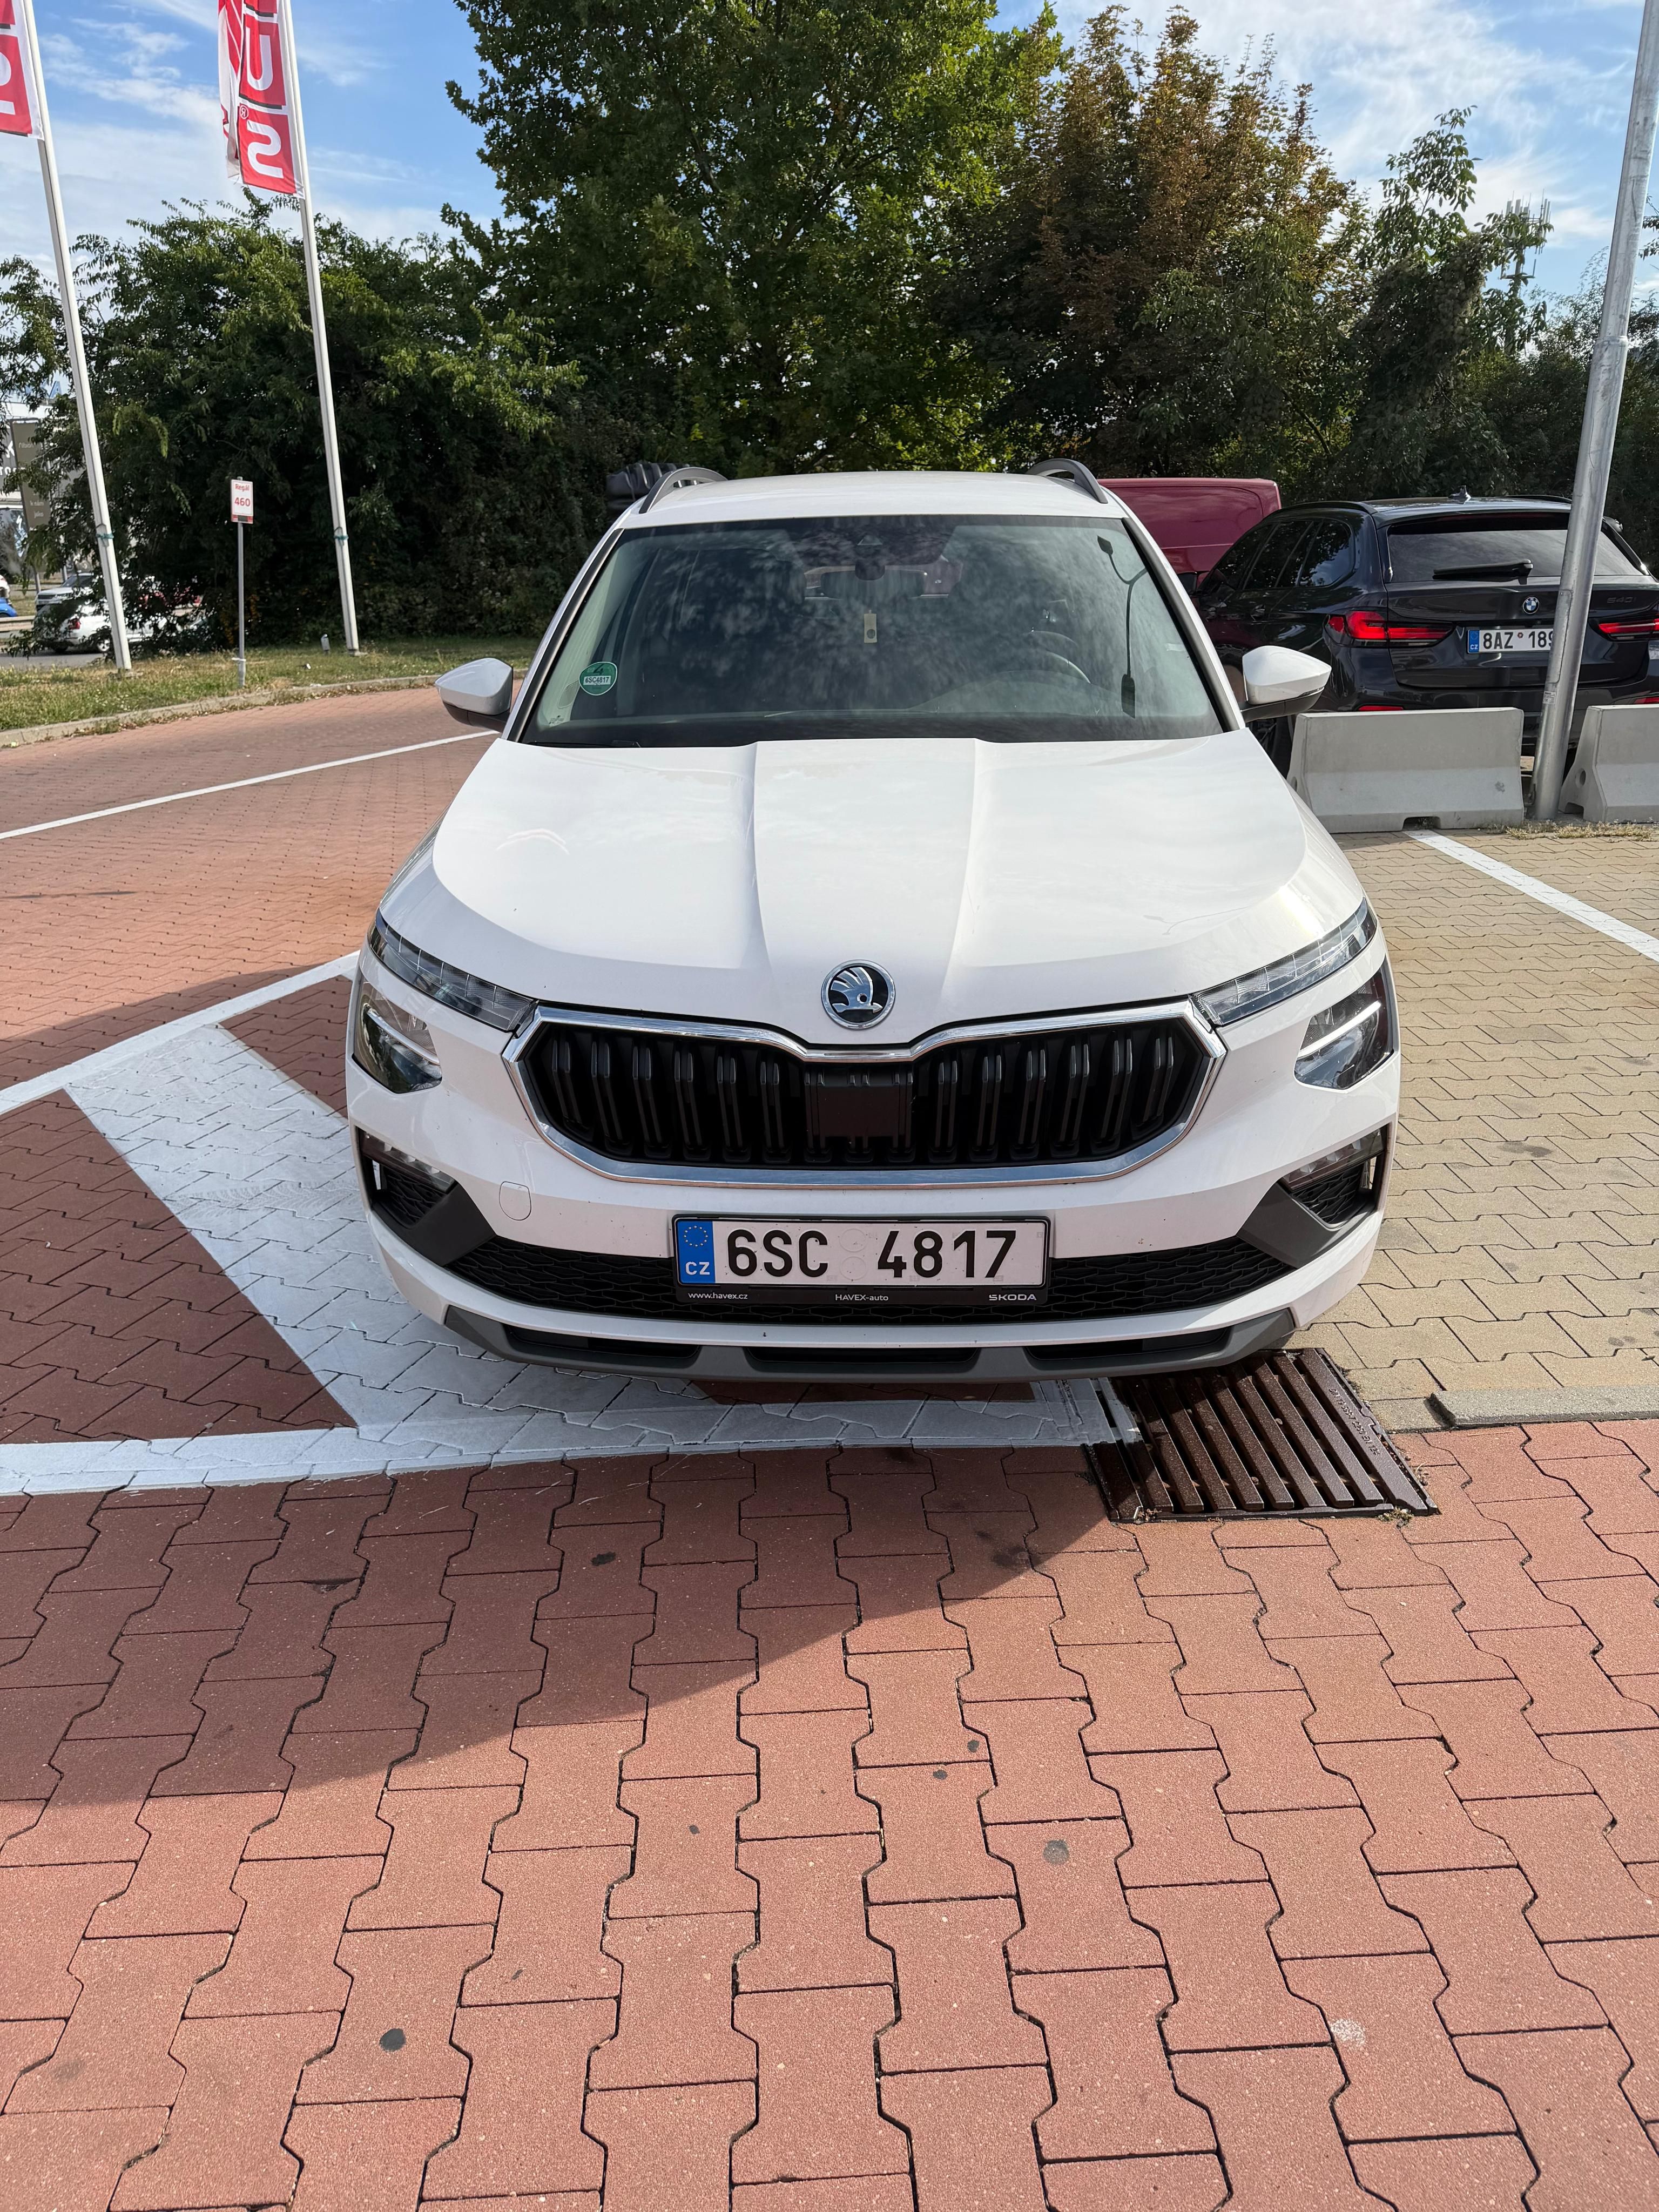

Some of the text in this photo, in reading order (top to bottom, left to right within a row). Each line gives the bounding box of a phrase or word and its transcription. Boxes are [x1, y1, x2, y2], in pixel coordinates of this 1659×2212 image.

[234, 497, 251, 507] 460
[1483, 632, 1513, 649] 8AZ
[727, 1229, 1016, 1278] 6SC 4817
[685, 1262, 710, 1275] CZ
